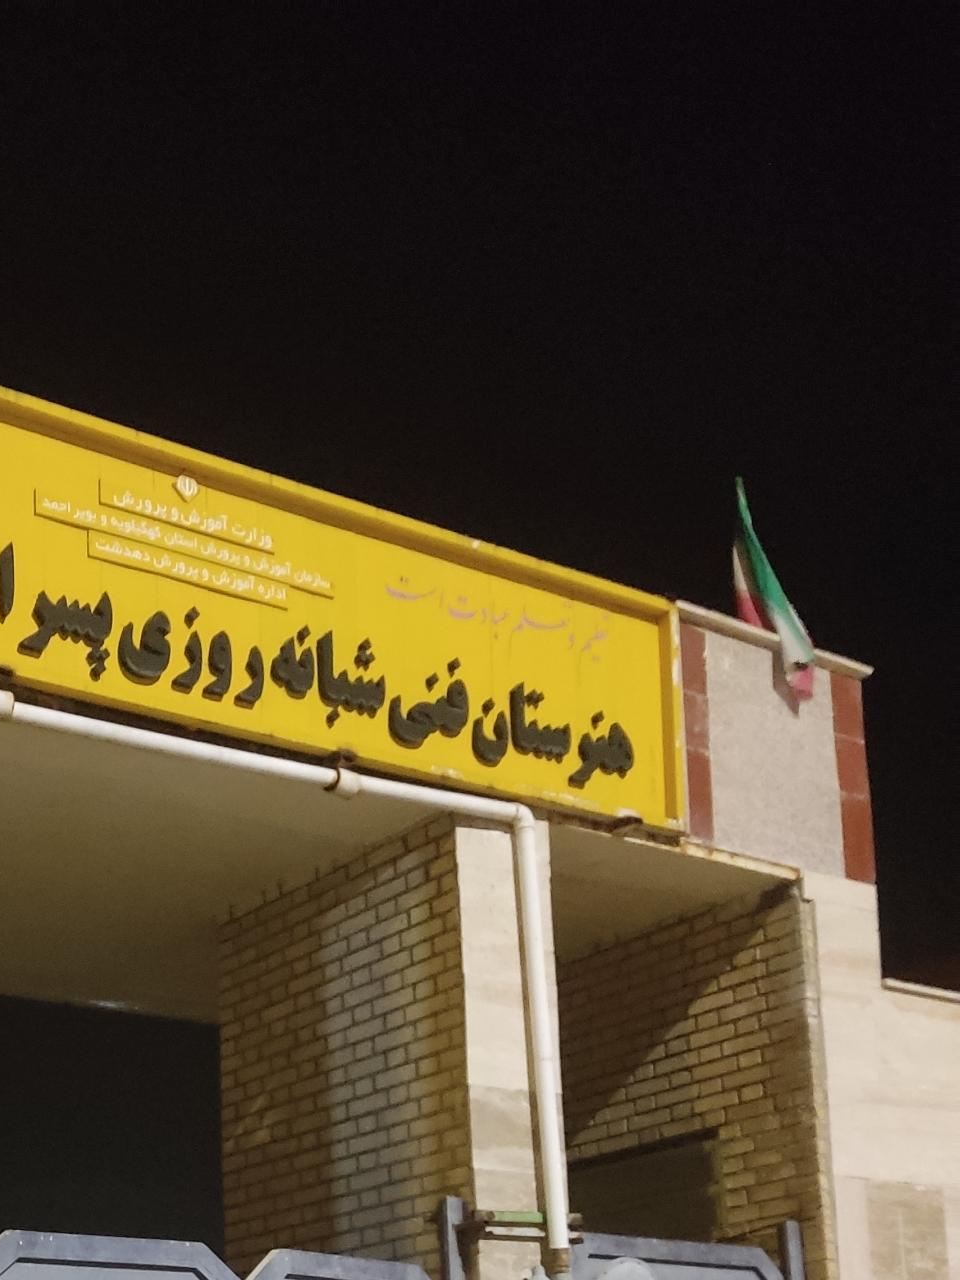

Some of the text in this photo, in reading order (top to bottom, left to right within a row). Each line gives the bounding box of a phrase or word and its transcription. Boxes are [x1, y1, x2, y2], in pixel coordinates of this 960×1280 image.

[42, 497, 71, 513] احمد
[113, 490, 273, 550] وزارت آموزش و پرورش
[95, 537, 151, 562] دهدشت
[164, 530, 198, 549] استان
[200, 540, 241, 566] پرورش
[153, 554, 199, 578] پرورش
[252, 556, 292, 577] آموزش
[212, 570, 255, 591] آموزش
[293, 569, 331, 590] سازمان
[257, 582, 287, 601] اداره
[388, 658, 469, 750] فنی
[471, 682, 634, 789] هنرستان
